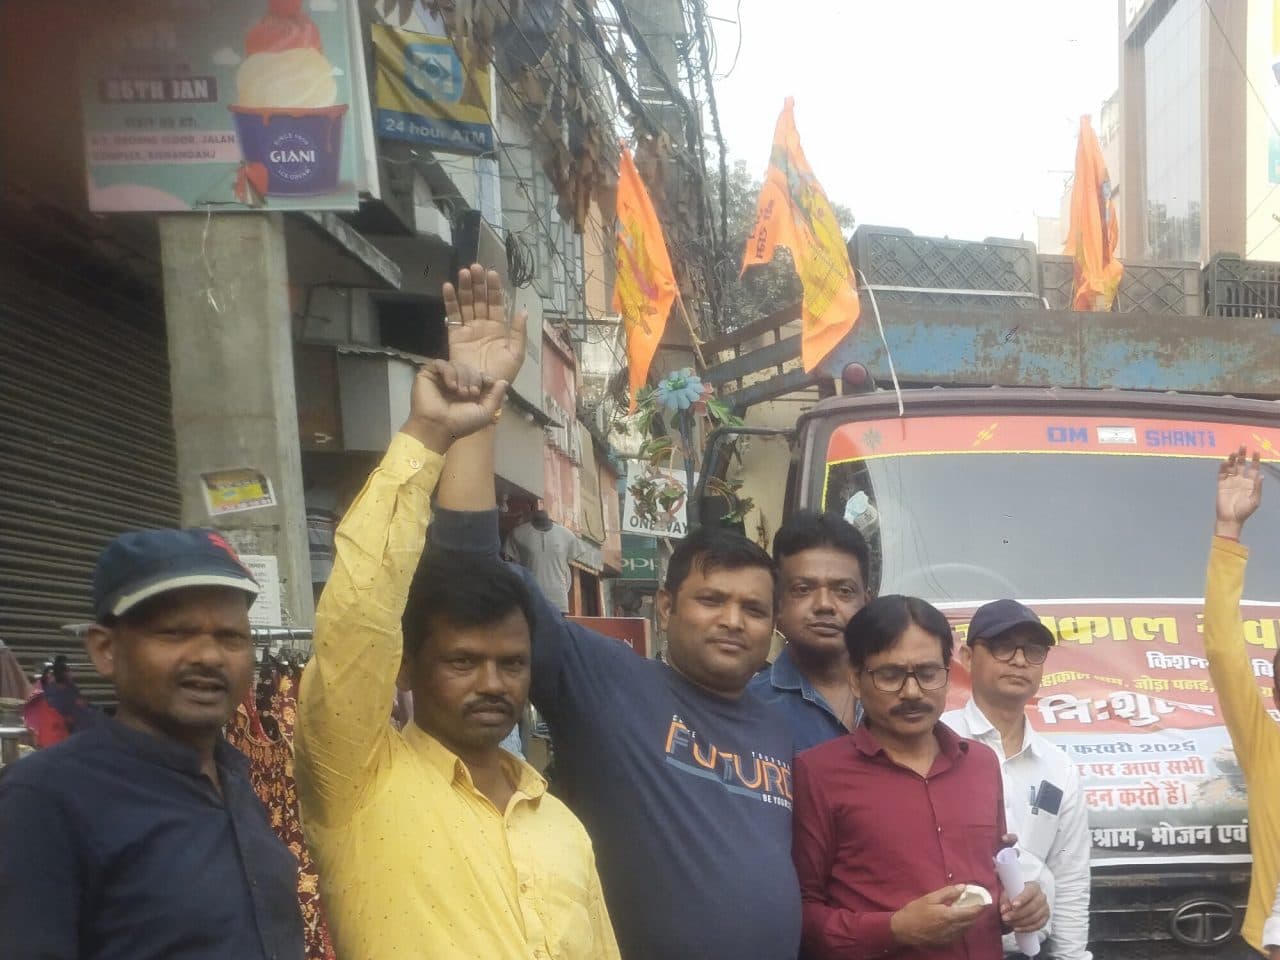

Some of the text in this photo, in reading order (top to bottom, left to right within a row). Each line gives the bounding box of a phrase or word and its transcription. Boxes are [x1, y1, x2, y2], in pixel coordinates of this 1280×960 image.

[172, 79, 209, 99] JAN
[385, 117, 405, 133] 24
[452, 129, 486, 145] ATM
[270, 150, 316, 164] GIANI
[1047, 426, 1089, 443] OM
[1138, 739, 1197, 754] 2025
[1090, 762, 1116, 777] पर
[1120, 760, 1161, 776] आप
[1166, 756, 1205, 776] सभी
[1118, 781, 1160, 807] करते
[1151, 821, 1213, 846] भोजन
[1216, 819, 1250, 844] एवं
